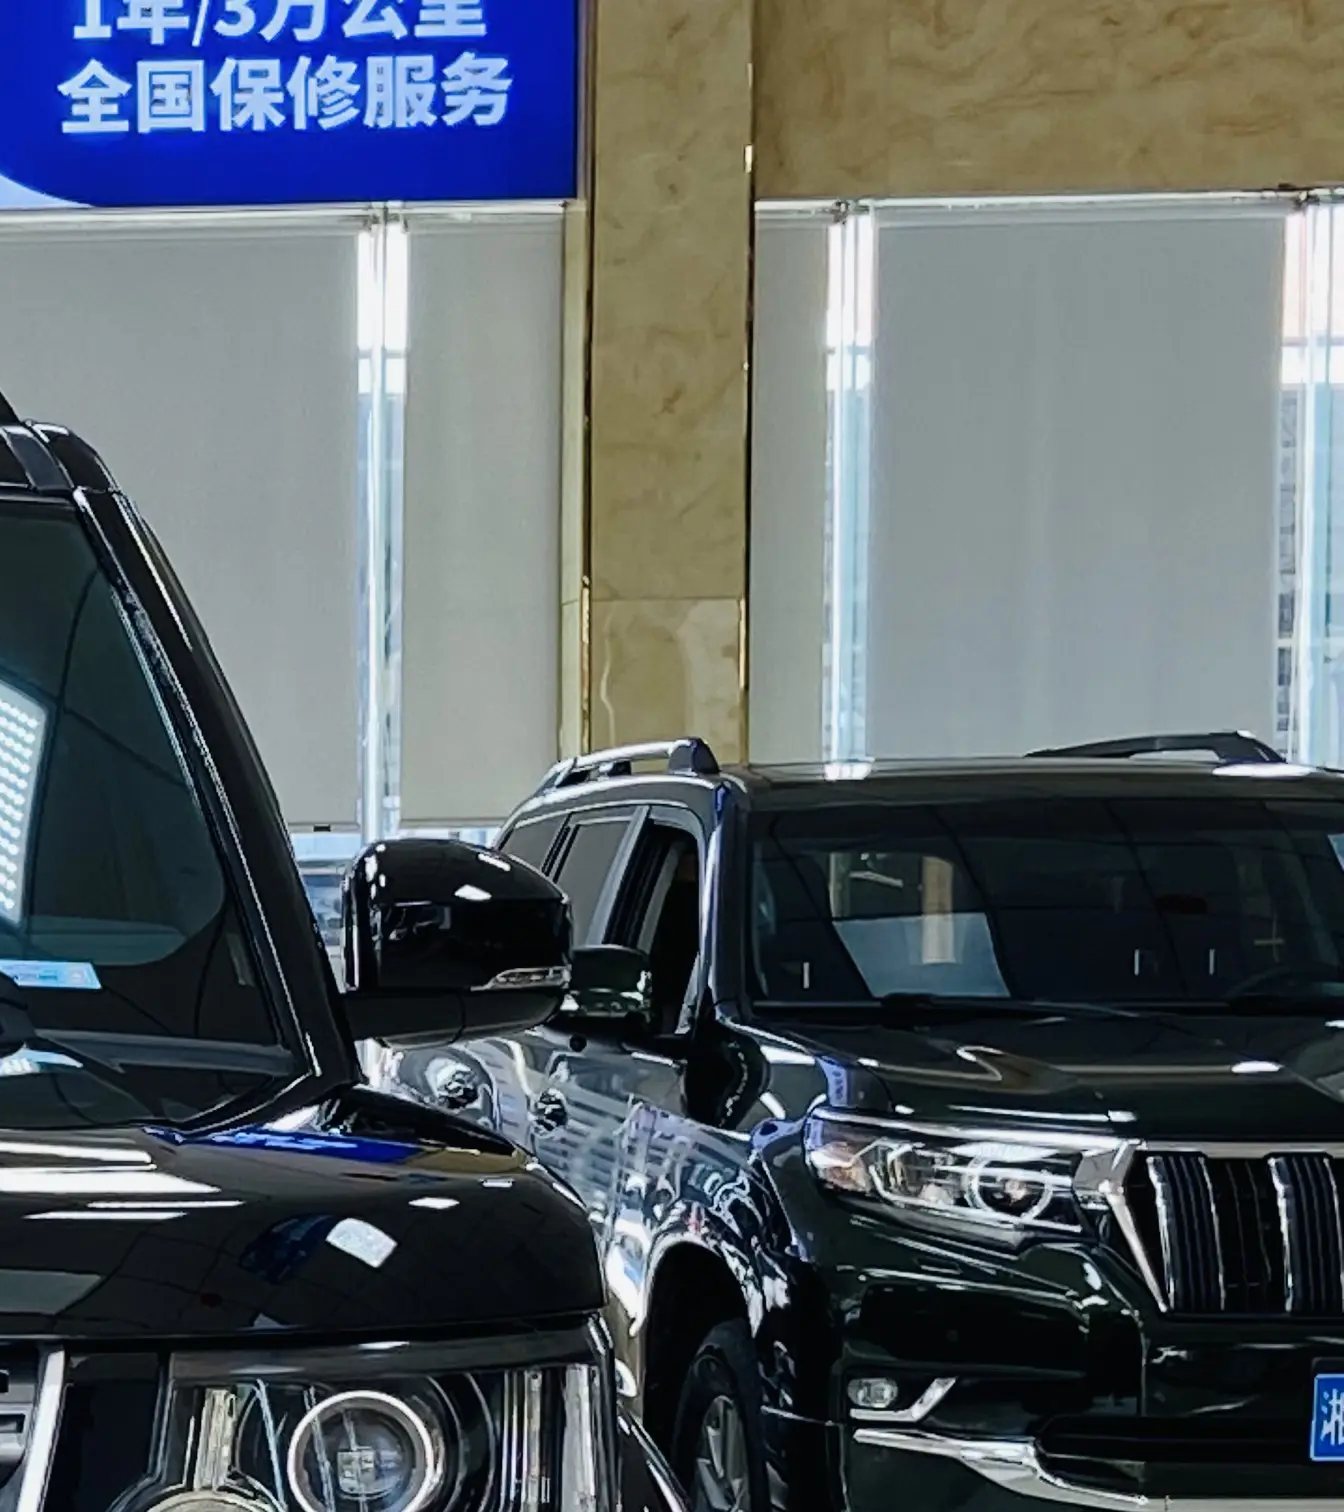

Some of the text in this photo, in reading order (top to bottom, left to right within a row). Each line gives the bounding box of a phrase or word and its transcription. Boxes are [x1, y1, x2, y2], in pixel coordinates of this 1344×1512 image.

[57, 52, 512, 134] 全国保修服务
